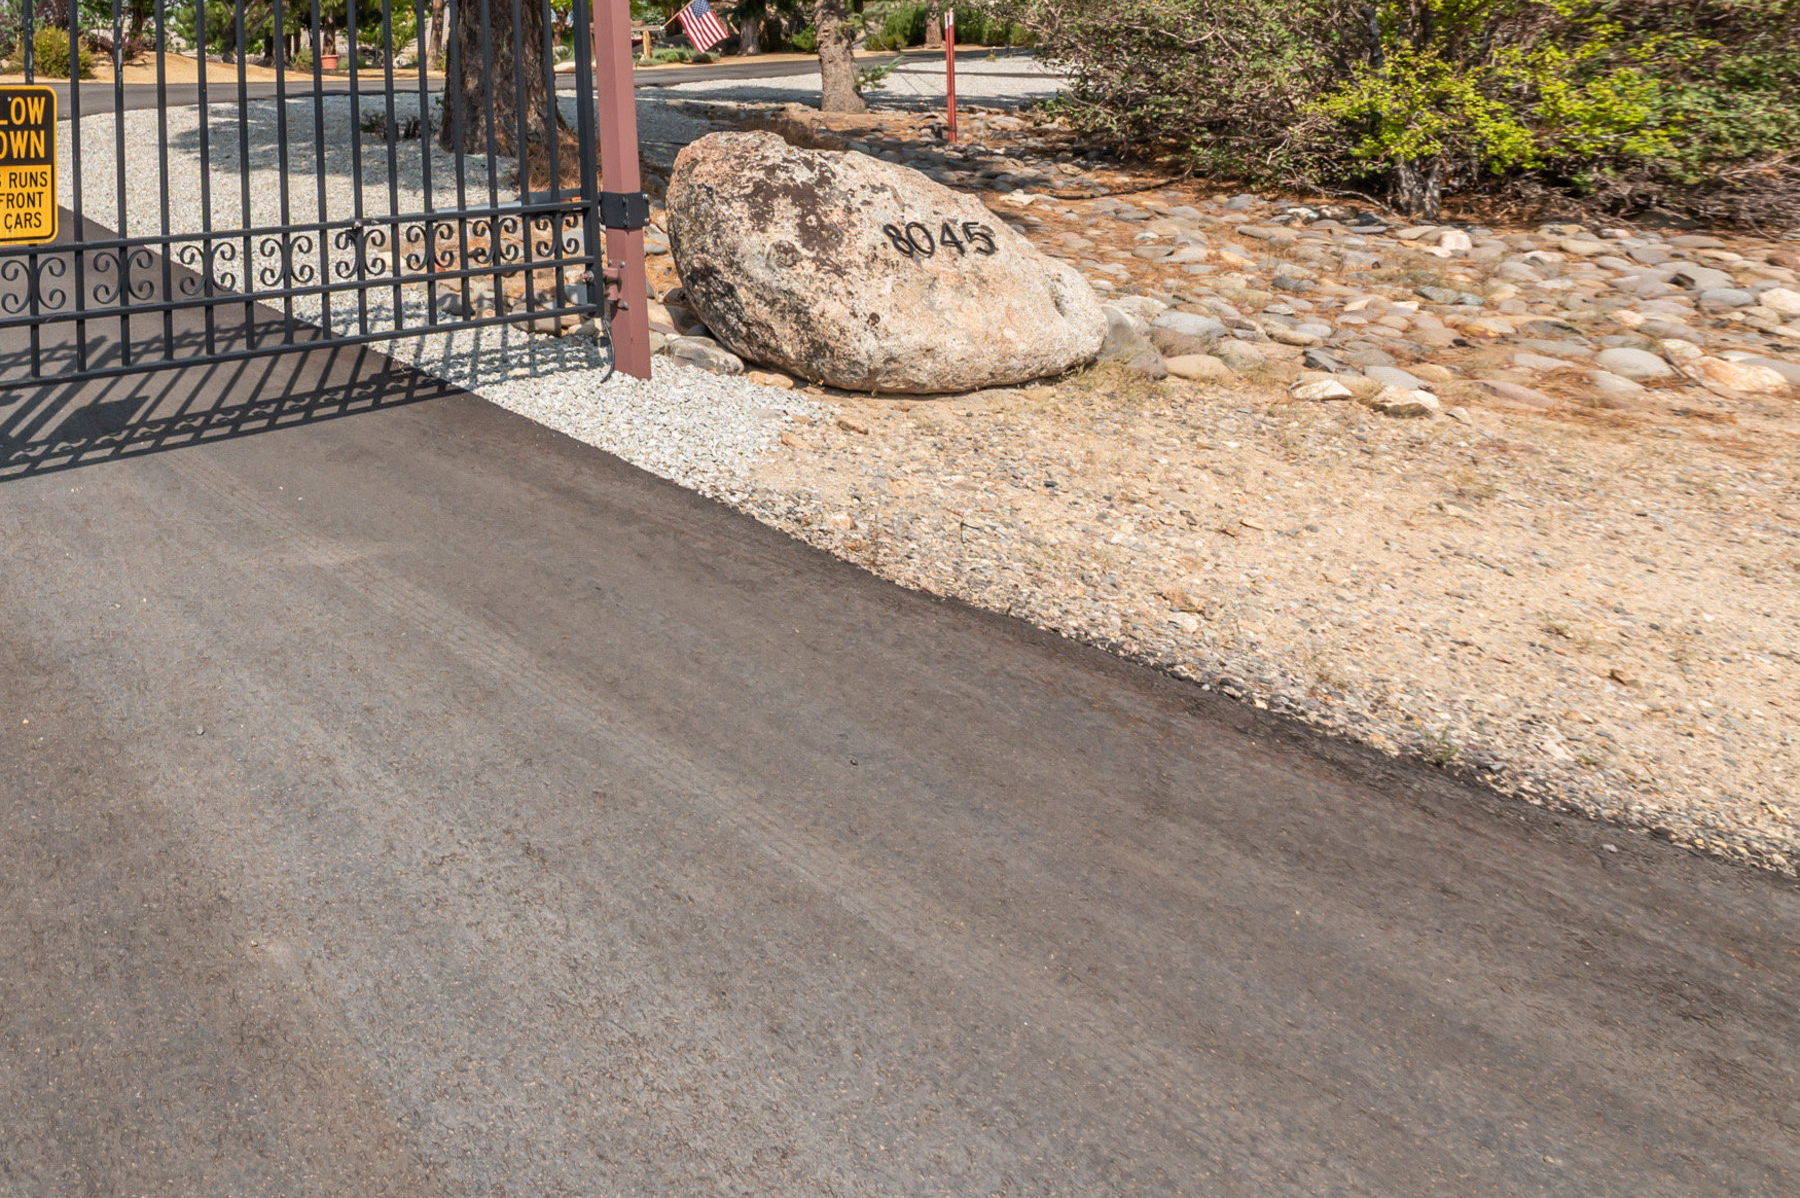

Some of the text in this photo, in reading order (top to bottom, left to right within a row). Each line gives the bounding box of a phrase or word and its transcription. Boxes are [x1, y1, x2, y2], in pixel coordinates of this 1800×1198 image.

[8, 171, 48, 189] RUNS
[4, 212, 42, 230] CARS
[883, 221, 997, 259] 8045
